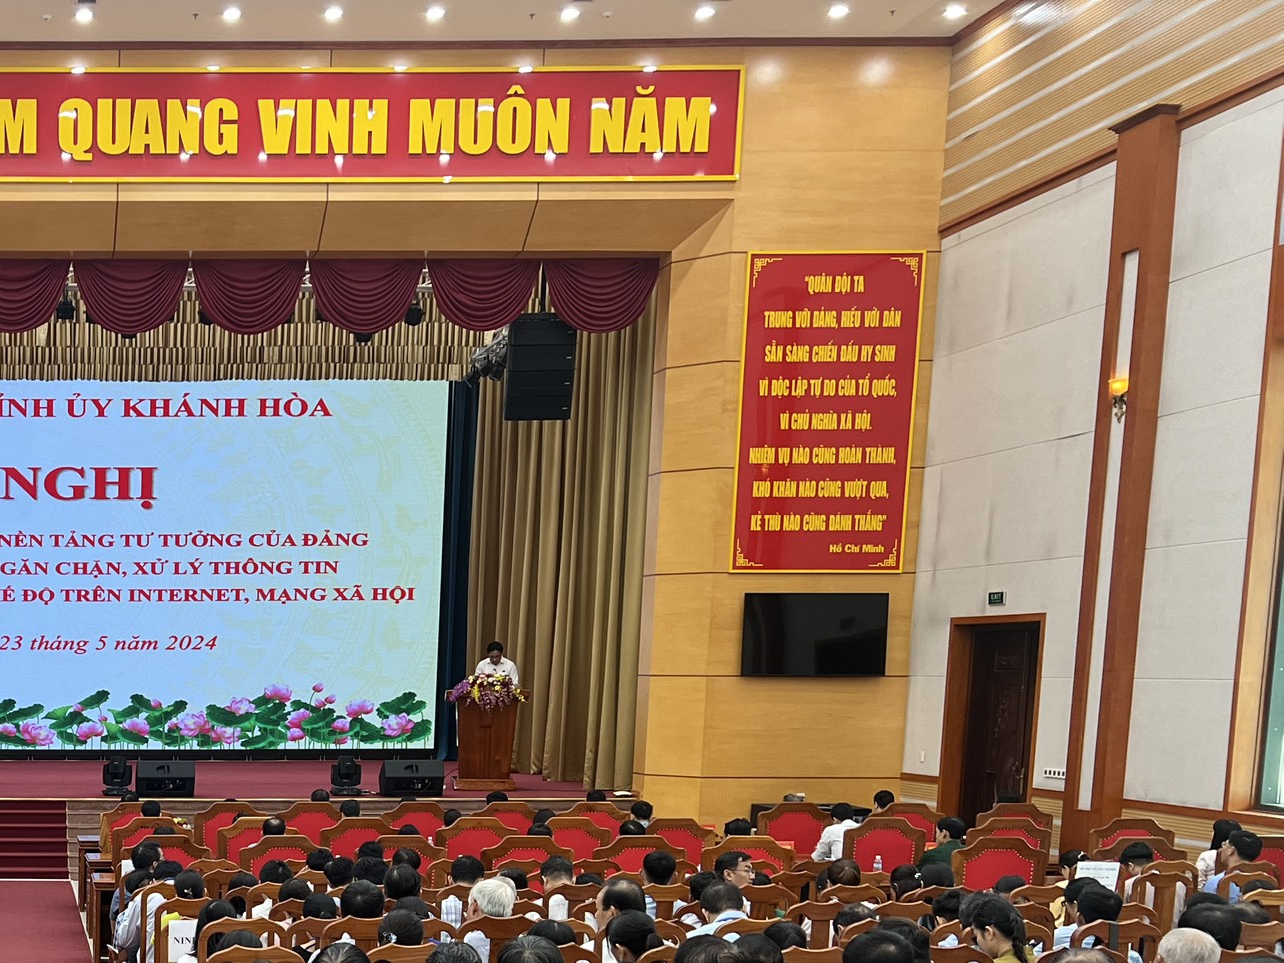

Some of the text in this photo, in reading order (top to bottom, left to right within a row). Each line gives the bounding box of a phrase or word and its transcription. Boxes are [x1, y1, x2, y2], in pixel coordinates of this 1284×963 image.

[58, 98, 239, 160] QUANG
[258, 98, 388, 154] VINH
[408, 85, 570, 155] MUÔN
[589, 86, 711, 154] NĂM
[835, 273, 851, 294] ĐỘI
[854, 276, 864, 292] TA
[764, 311, 792, 328] TRUNG
[813, 307, 838, 329] ĐẢNG,
[841, 306, 861, 327] HIẾU
[883, 307, 901, 327] DÂN
[786, 343, 809, 362] SÀNG
[861, 345, 873, 362] HY
[875, 345, 896, 362] SINH
[760, 377, 768, 396] VÌ
[771, 376, 789, 398] ĐỘC
[792, 377, 807, 398] LẬP
[810, 377, 822, 398] TỰ
[823, 379, 836, 396] DO
[838, 375, 855, 396] CỦA
[66, 393, 112, 417] ỦY
[122, 393, 247, 417] KHÁNH
[257, 393, 333, 417] HÒA
[780, 409, 872, 431] VÌ CHỦ NGHĨA XÃ HỘI.
[778, 448, 790, 466] VỤ
[792, 445, 810, 464] NÀO
[812, 445, 836, 464] CŨNG
[839, 445, 862, 463] HOÀN
[866, 444, 896, 464] THÀNH,
[0, 467, 158, 510] NGHỊ
[753, 478, 889, 499] KHÓ KHĂN NÀO CŨNG VƯỢT QUA,
[764, 512, 781, 531] THÙ
[783, 512, 800, 531] NÀO
[829, 512, 852, 531] ĐÁNH
[50, 531, 114, 547] TẢNG
[120, 533, 155, 547] TƯ
[159, 532, 242, 547] TƯỞNG
[249, 532, 297, 547] CỦA
[302, 530, 369, 547] ĐẢNG
[56, 560, 128, 578] CHẶN,
[133, 558, 168, 576] XỬ
[174, 559, 205, 576] LÝ
[210, 559, 293, 576] THÔNG
[299, 561, 339, 576] TIN
[22, 587, 54, 605] ĐỘ
[61, 587, 121, 602] TRÊN
[128, 589, 249, 604] INTERNET,
[256, 588, 327, 604] MẠNG
[333, 586, 366, 602] XÃ
[372, 587, 416, 604] HỘI
[30, 635, 89, 655] tháng
[95, 636, 107, 651] 5
[115, 637, 159, 651] năm
[165, 635, 218, 651] 2024
